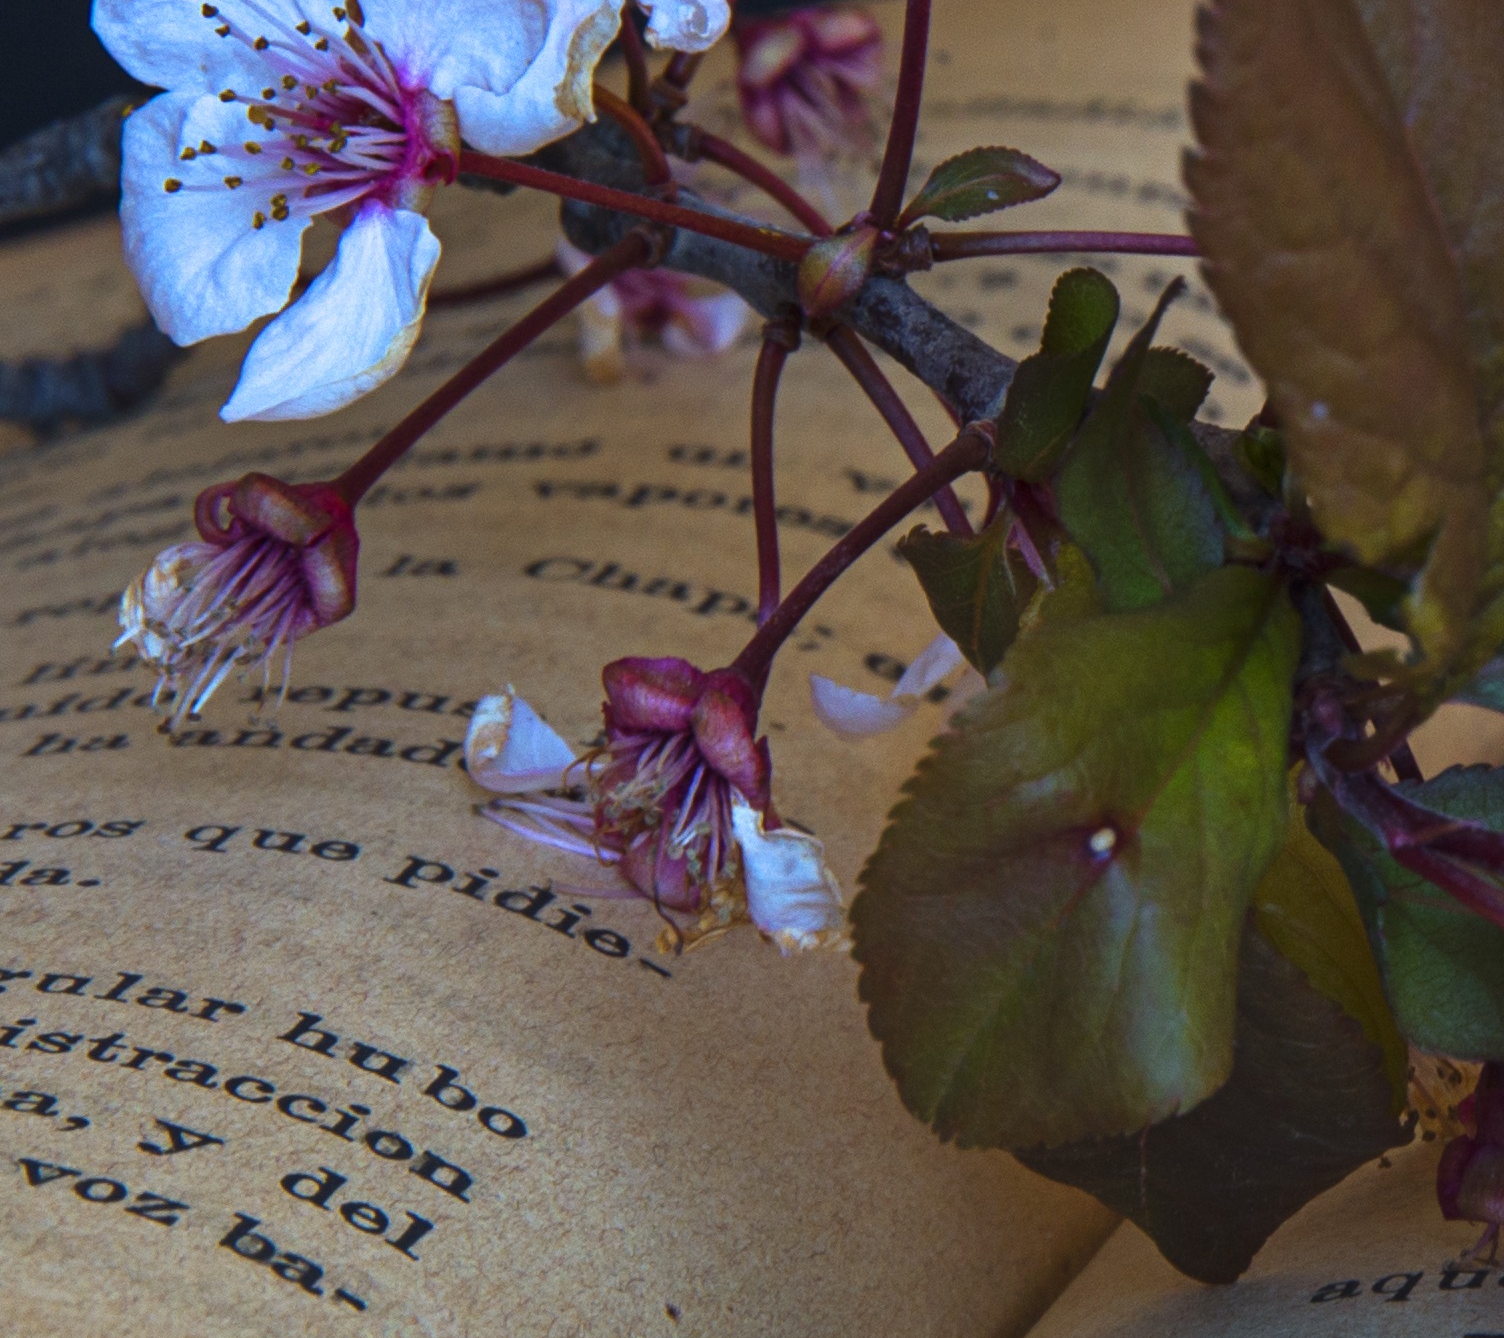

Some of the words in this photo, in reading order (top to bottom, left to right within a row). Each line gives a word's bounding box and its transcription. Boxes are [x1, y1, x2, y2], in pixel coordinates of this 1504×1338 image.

[185, 826, 360, 861] que
[389, 855, 671, 978] pidie-
[278, 1012, 528, 1140] hubo
[18, 1157, 189, 1227] voz
[220, 1212, 367, 1312] ba-
[138, 1119, 225, 1156] y
[280, 1166, 434, 1261] del
